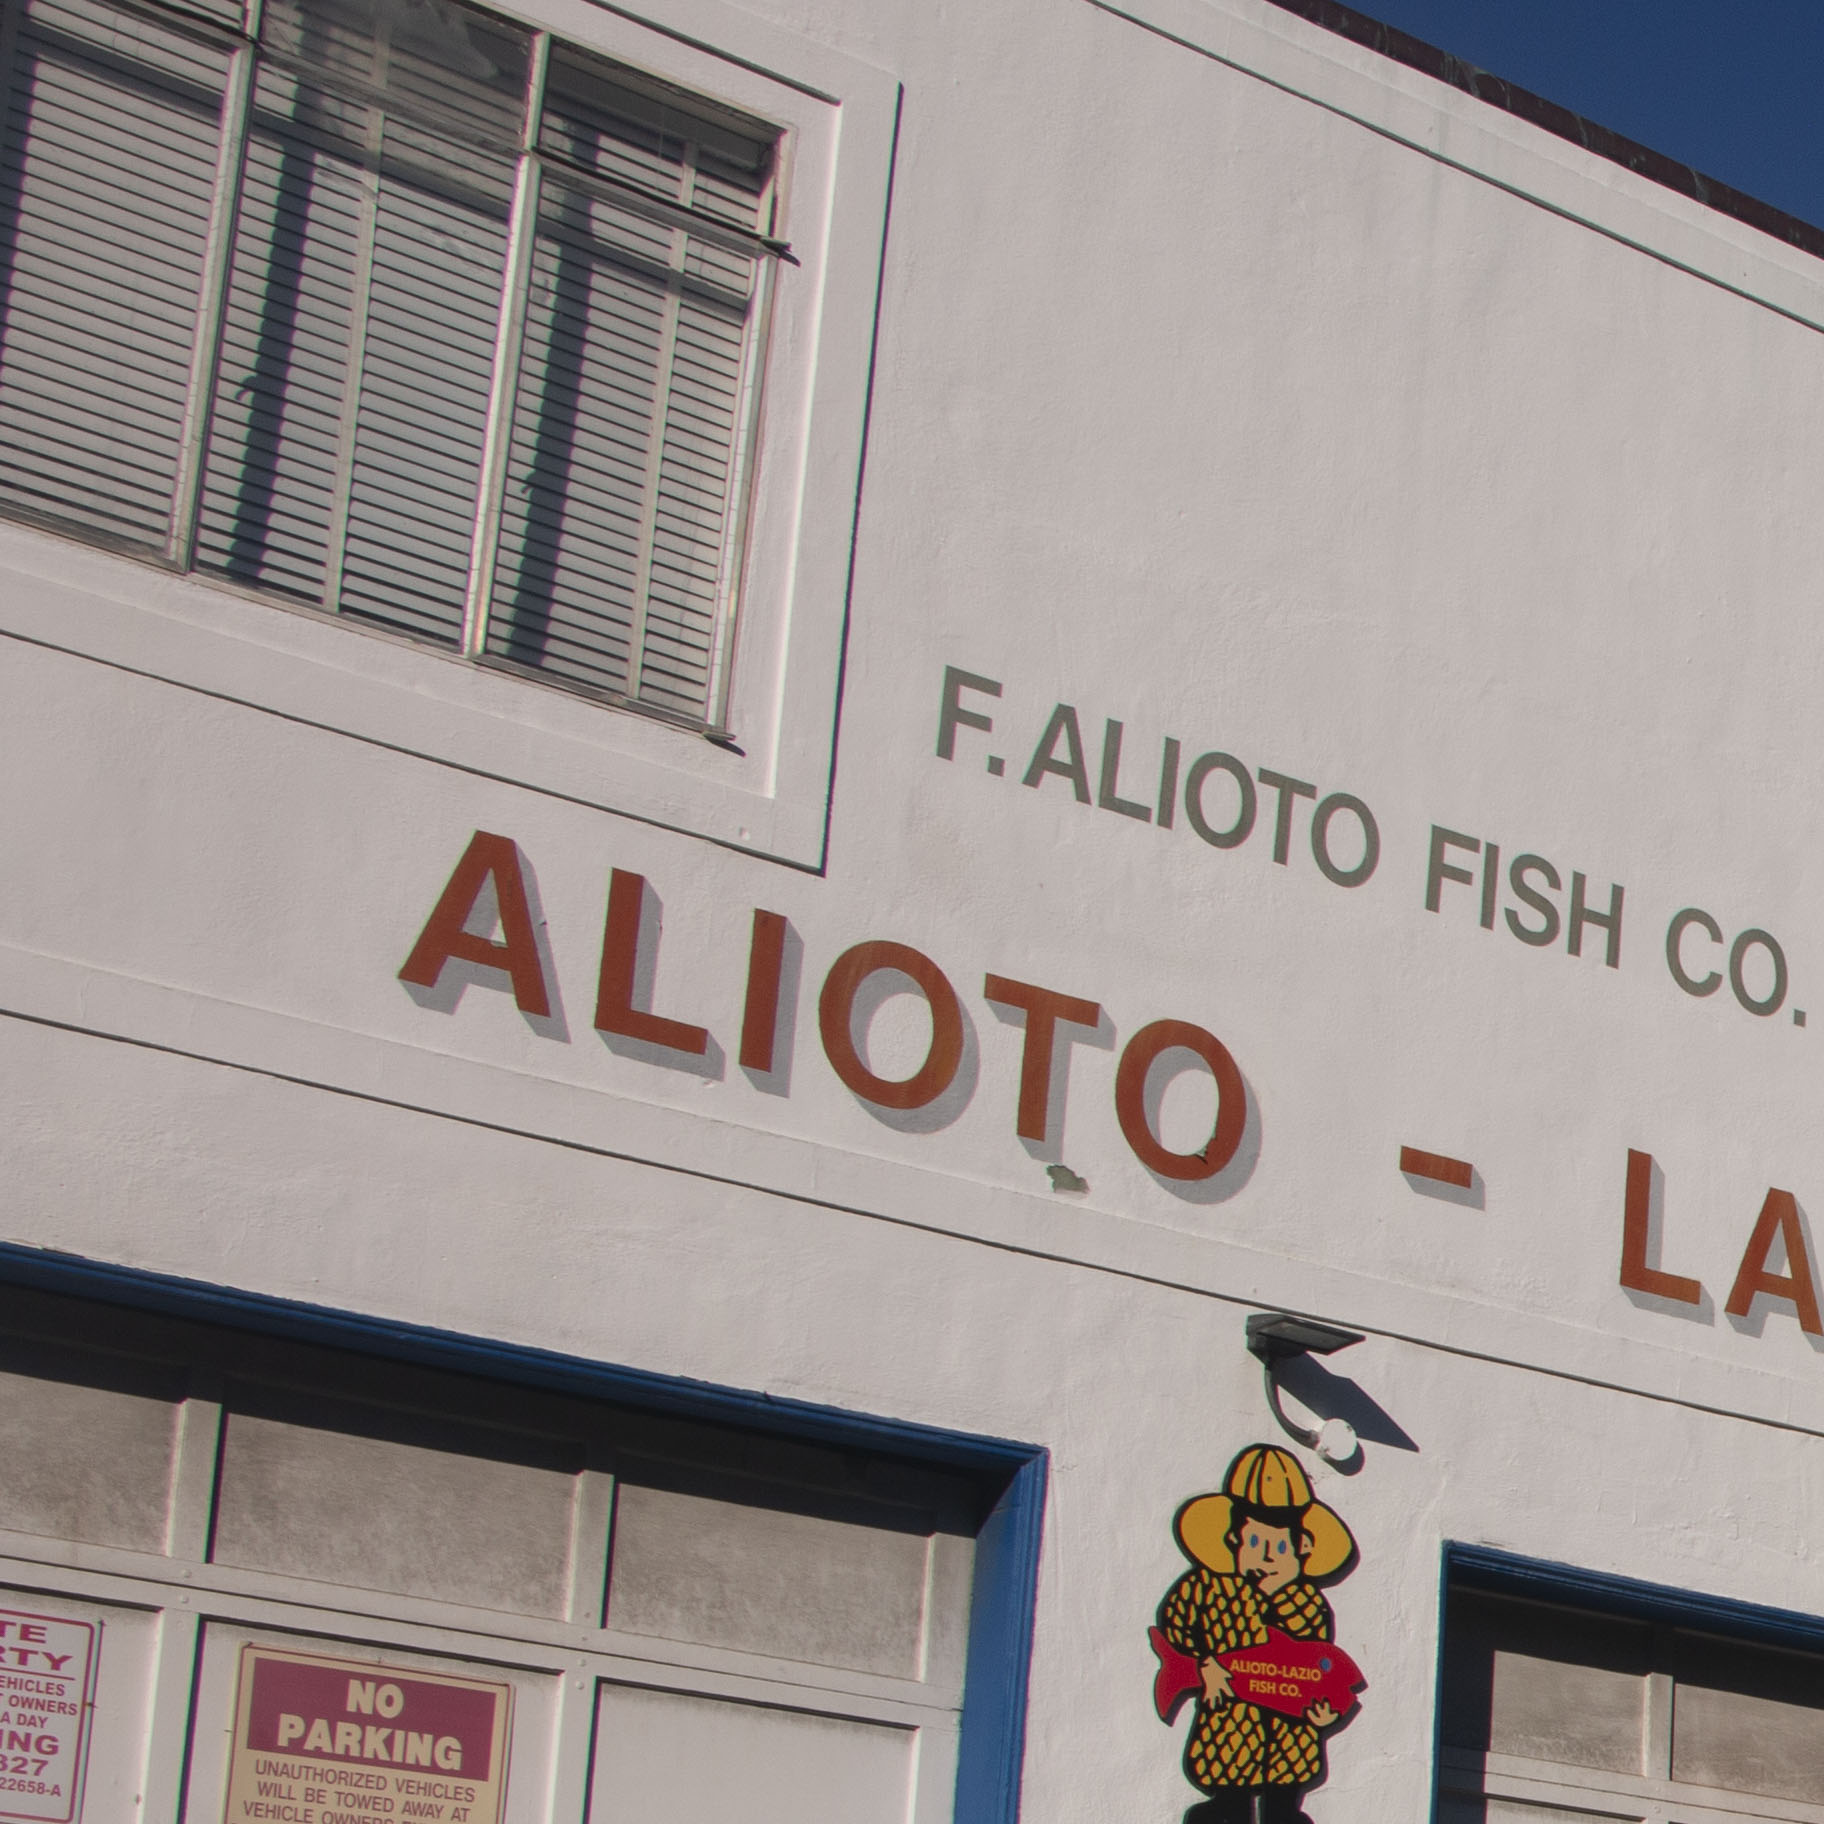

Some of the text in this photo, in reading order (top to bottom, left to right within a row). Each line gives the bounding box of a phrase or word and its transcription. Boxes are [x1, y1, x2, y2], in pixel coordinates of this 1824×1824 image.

[1424, 824, 1625, 970] FISH
[1665, 907, 1807, 1028] CO.
[397, 829, 1247, 1182] ALIOTO
[1230, 1659, 1322, 1682] ALIOTO-LAZIO
[1248, 1679, 1303, 1698] FISH CO.
[8, 1694, 79, 1716] OWNERS
[346, 1678, 405, 1719] NO
[16, 1713, 49, 1730] DAY
[277, 1712, 464, 1772] PARKING
[255, 1758, 476, 1803] UNAUTHORIZED VEHICLES
[243, 1800, 314, 1824] VEHICLE
[257, 1780, 471, 1824] WILL BE TOWED AWAY AT
